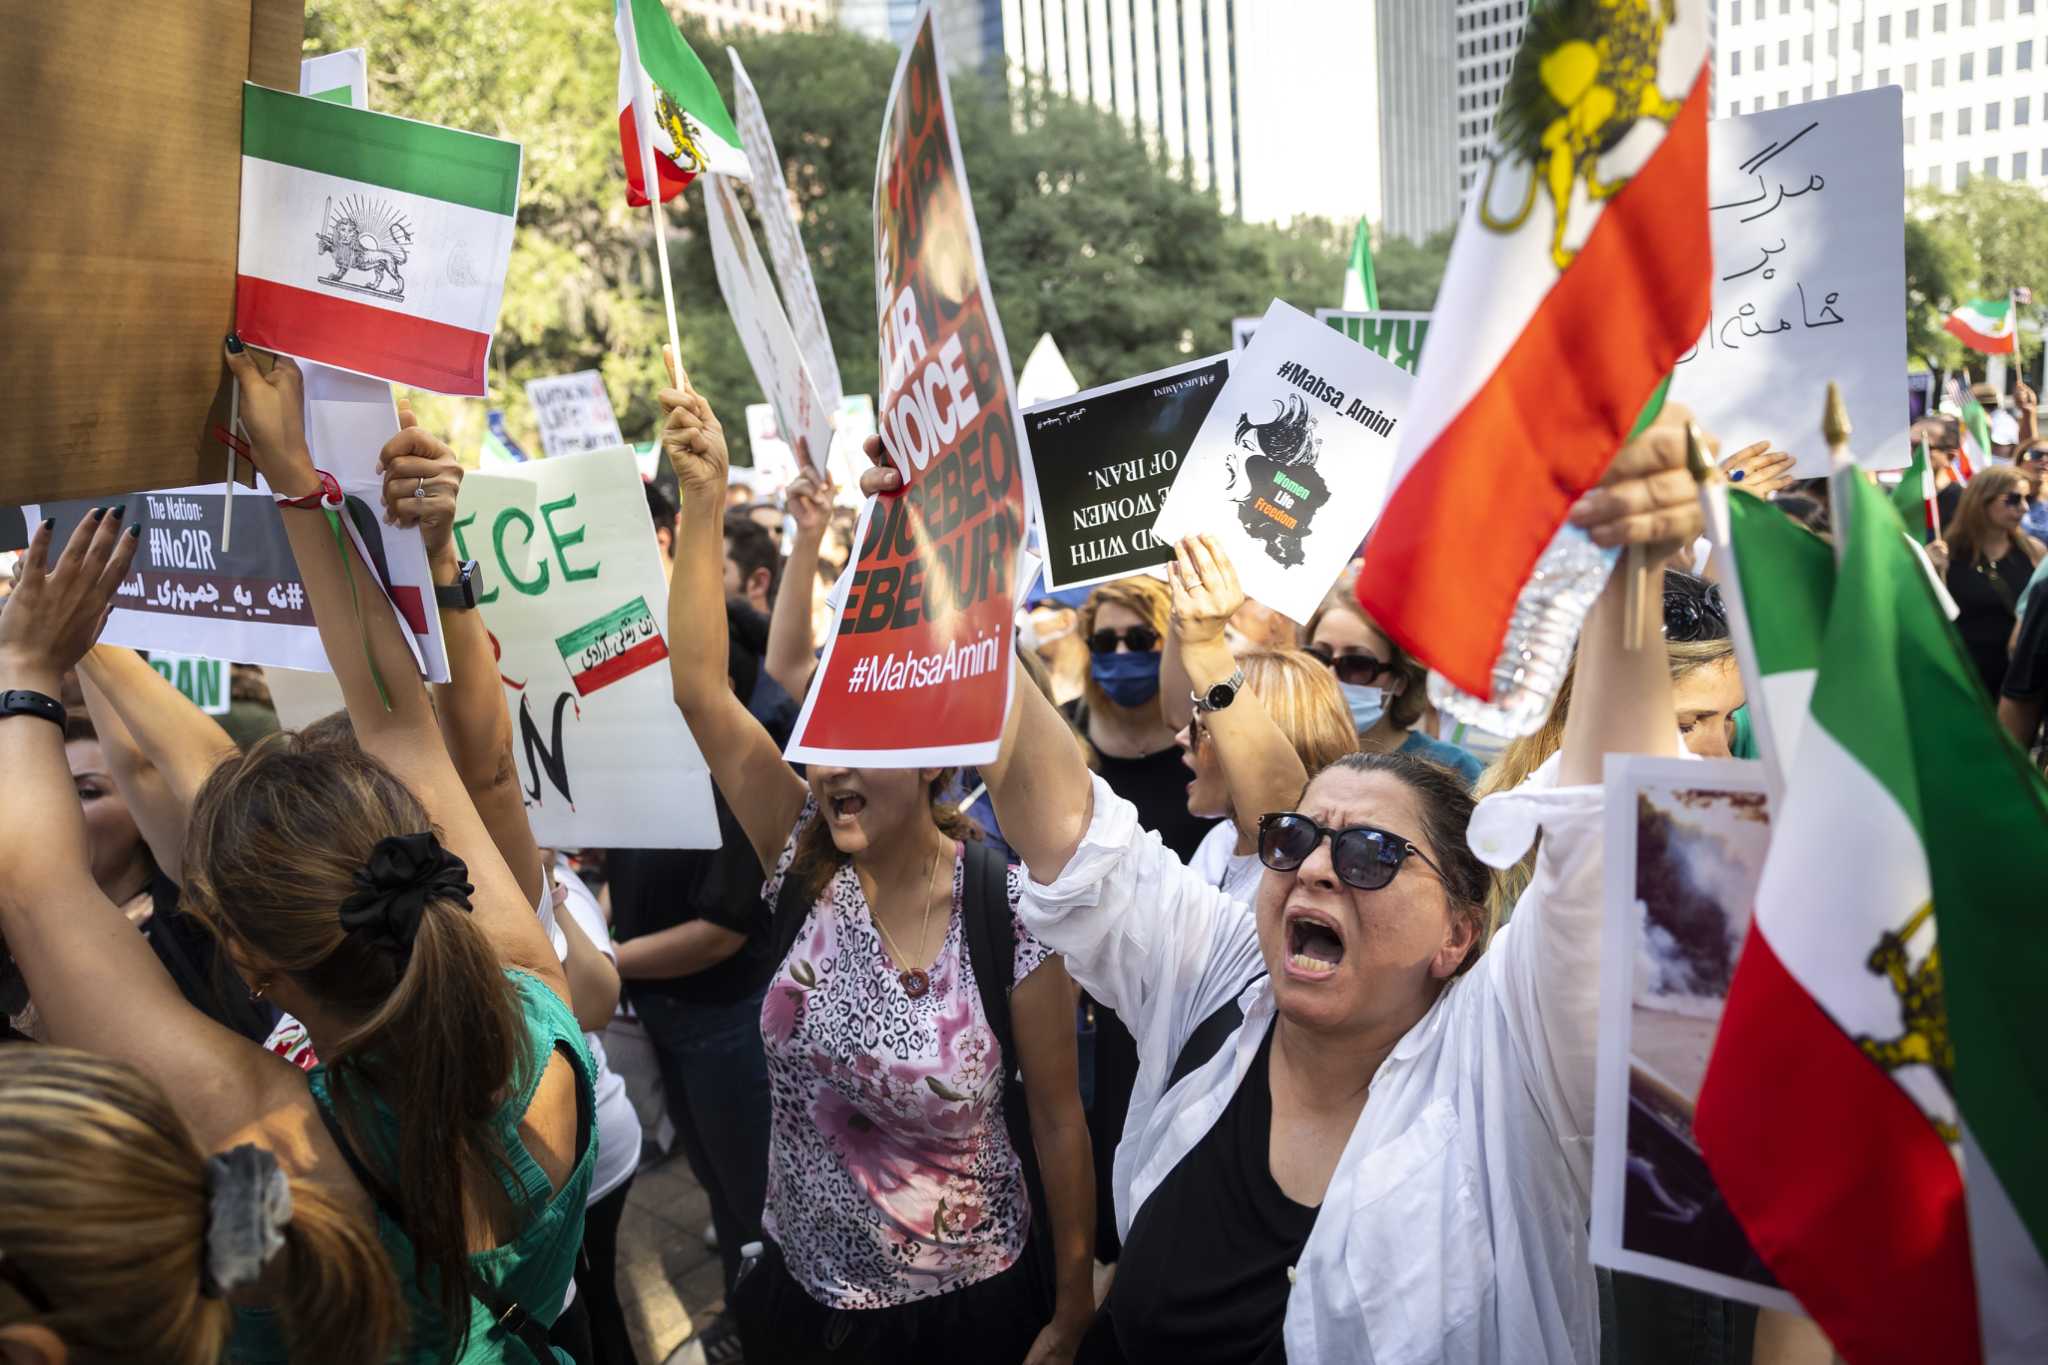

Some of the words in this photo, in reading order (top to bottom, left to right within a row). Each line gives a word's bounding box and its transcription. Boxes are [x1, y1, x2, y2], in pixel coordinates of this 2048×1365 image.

[1722, 237, 1787, 281] بر
[879, 331, 981, 486] VOICE
[1276, 360, 1398, 439] #Mahsa_Amini
[1087, 457, 1146, 491] IRAN.
[1149, 448, 1178, 477] OF
[1272, 470, 1311, 501] Women
[146, 495, 166, 521] The
[166, 496, 203, 522] Nation:
[1072, 492, 1157, 532] WOMEN
[1253, 496, 1298, 530] Freedom
[150, 527, 217, 571] #No2IR
[1069, 534, 1129, 567] WITH
[847, 623, 1001, 694] #MahsaAmini
